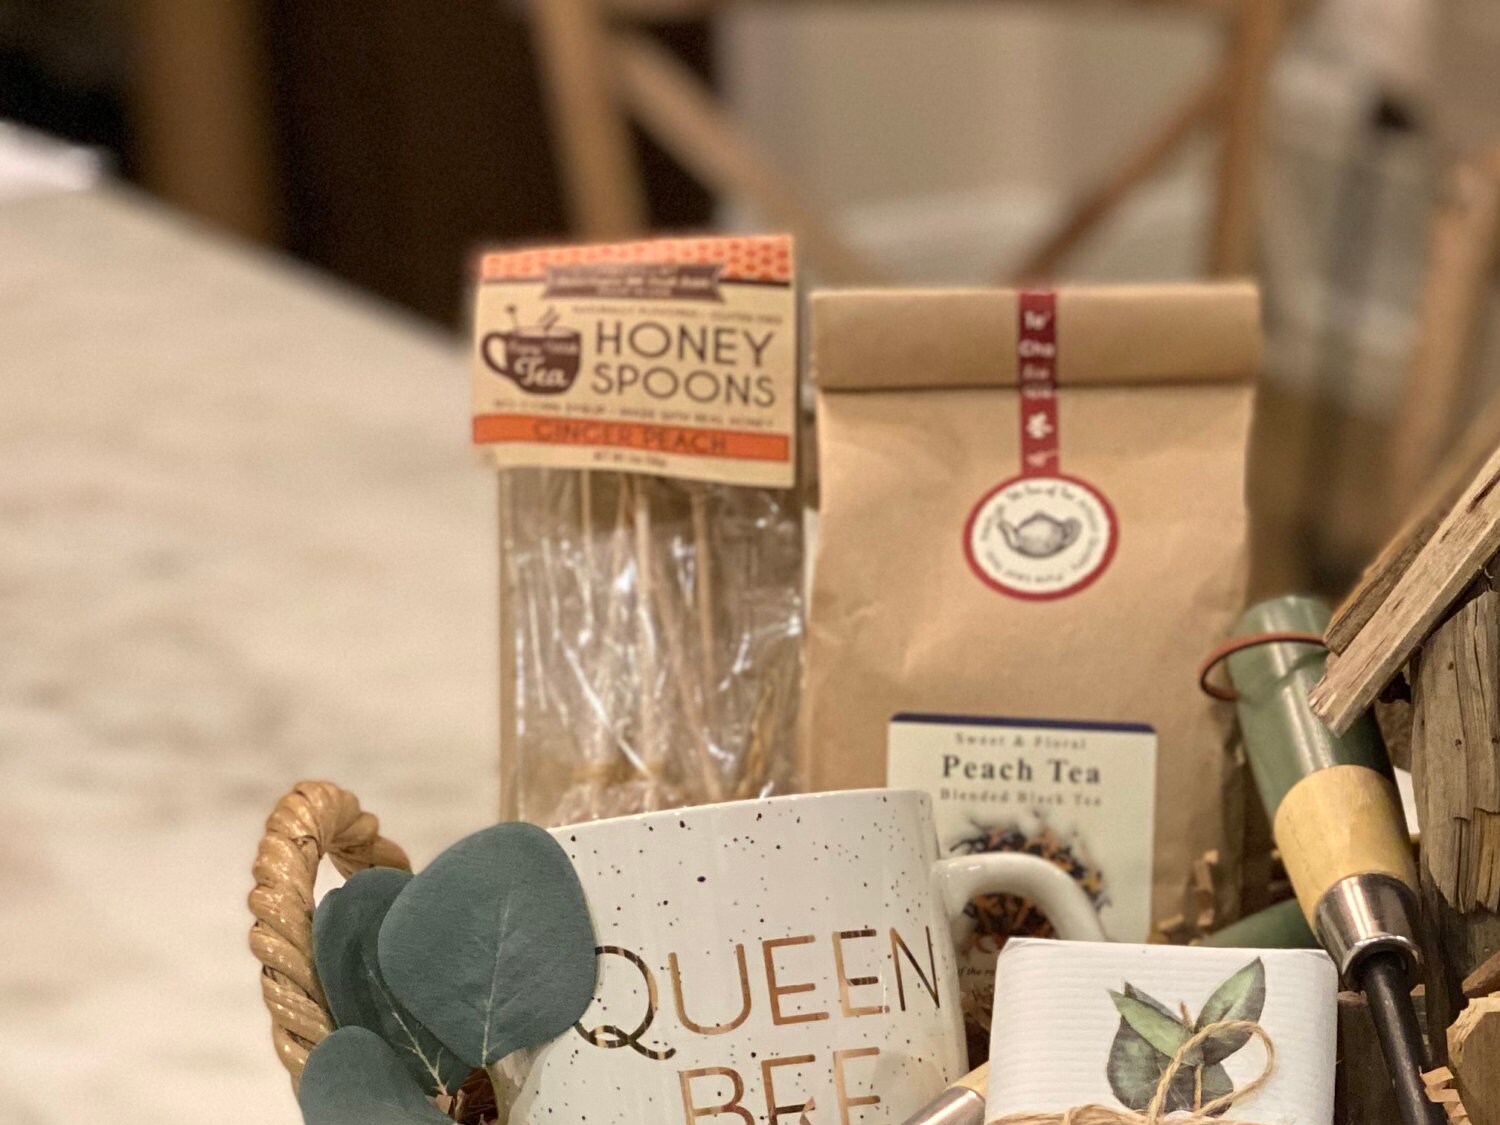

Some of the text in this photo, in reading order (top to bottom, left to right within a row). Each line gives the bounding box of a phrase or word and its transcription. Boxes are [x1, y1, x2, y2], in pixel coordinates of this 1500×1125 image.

[596, 320, 774, 367] HONEY
[514, 355, 568, 387] Tea
[591, 363, 775, 408] SPOONS
[534, 419, 727, 453] GINGER PEACH
[956, 732, 1086, 749] Sweet & Floral
[943, 754, 1100, 783] Peach Tea
[940, 788, 1102, 807] Blended Black Tea
[573, 925, 940, 1061] QUEEN
